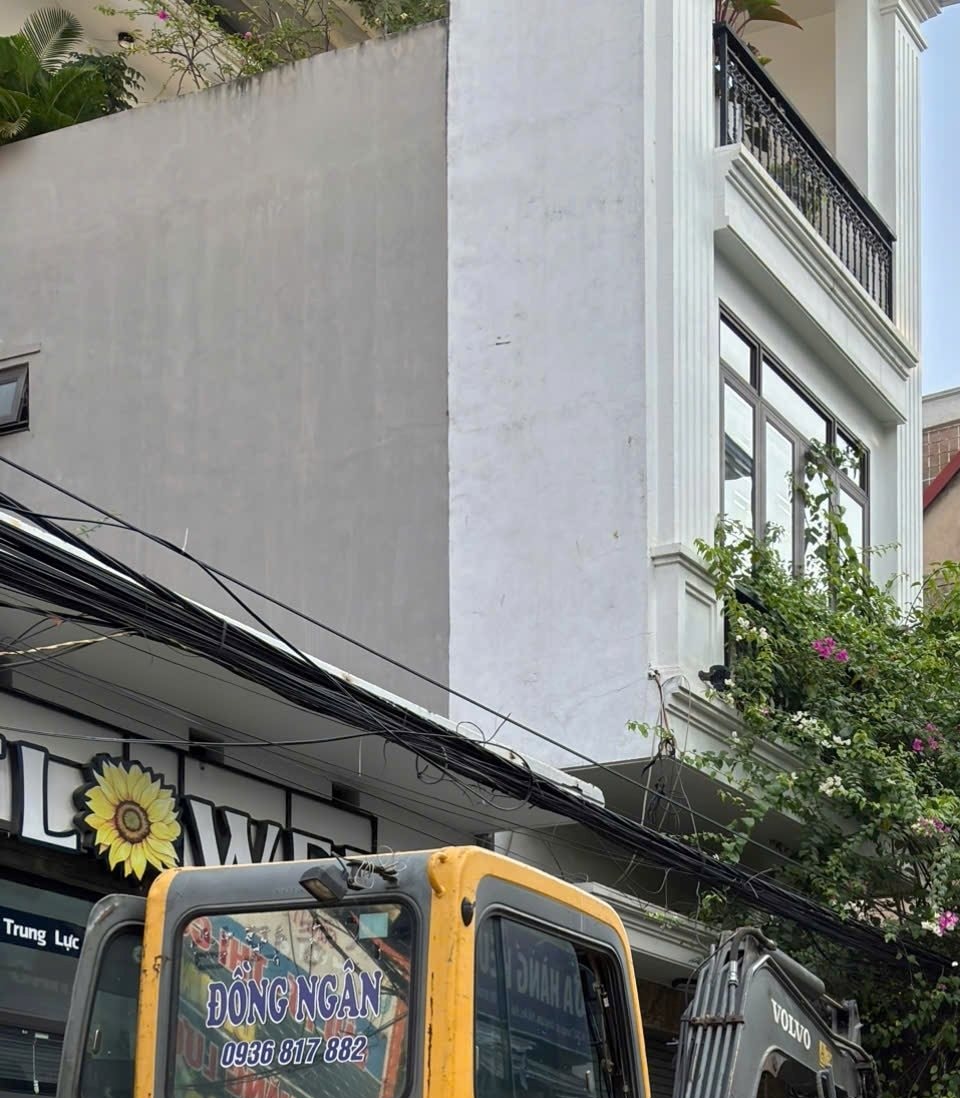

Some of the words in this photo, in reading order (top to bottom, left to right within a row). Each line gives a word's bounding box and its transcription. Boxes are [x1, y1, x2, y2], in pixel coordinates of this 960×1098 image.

[3, 917, 47, 946] Trung
[54, 929, 80, 951] Lực
[295, 958, 383, 1022] NGÂN
[771, 998, 811, 1050] VOLVO
[220, 1039, 275, 1068] 0936
[278, 1037, 322, 1065] 817
[324, 1035, 368, 1063] 882
